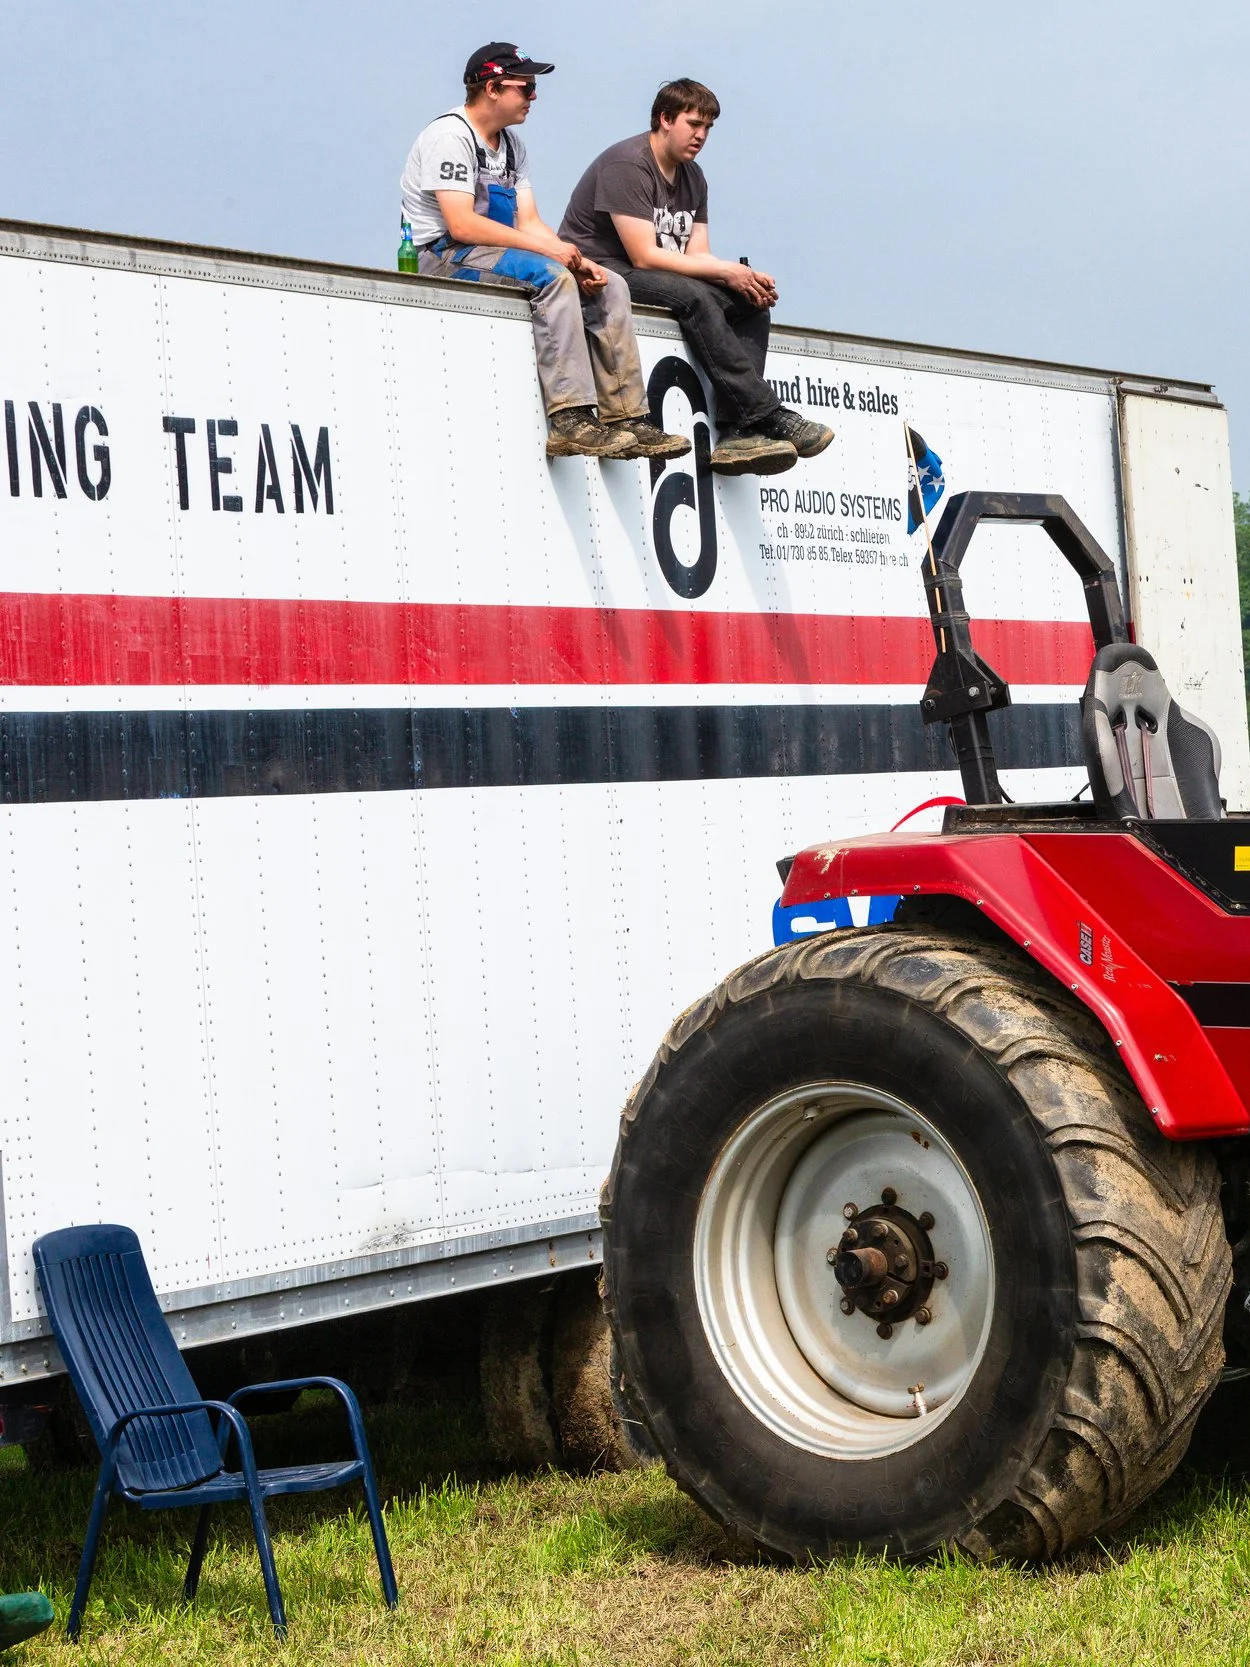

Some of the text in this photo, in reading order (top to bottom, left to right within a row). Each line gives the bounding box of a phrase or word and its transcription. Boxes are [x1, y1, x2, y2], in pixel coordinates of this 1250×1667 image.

[440, 161, 468, 182] 92
[805, 377, 840, 408] hire
[843, 382, 856, 410] &
[858, 386, 899, 415] sales
[162, 416, 335, 515] TEAM
[760, 488, 902, 521] PRO AUDIO SYSTEMS
[777, 523, 788, 538] ch
[816, 524, 844, 541] zürich
[850, 527, 890, 544] schlieren
[830, 547, 853, 563] Telex
